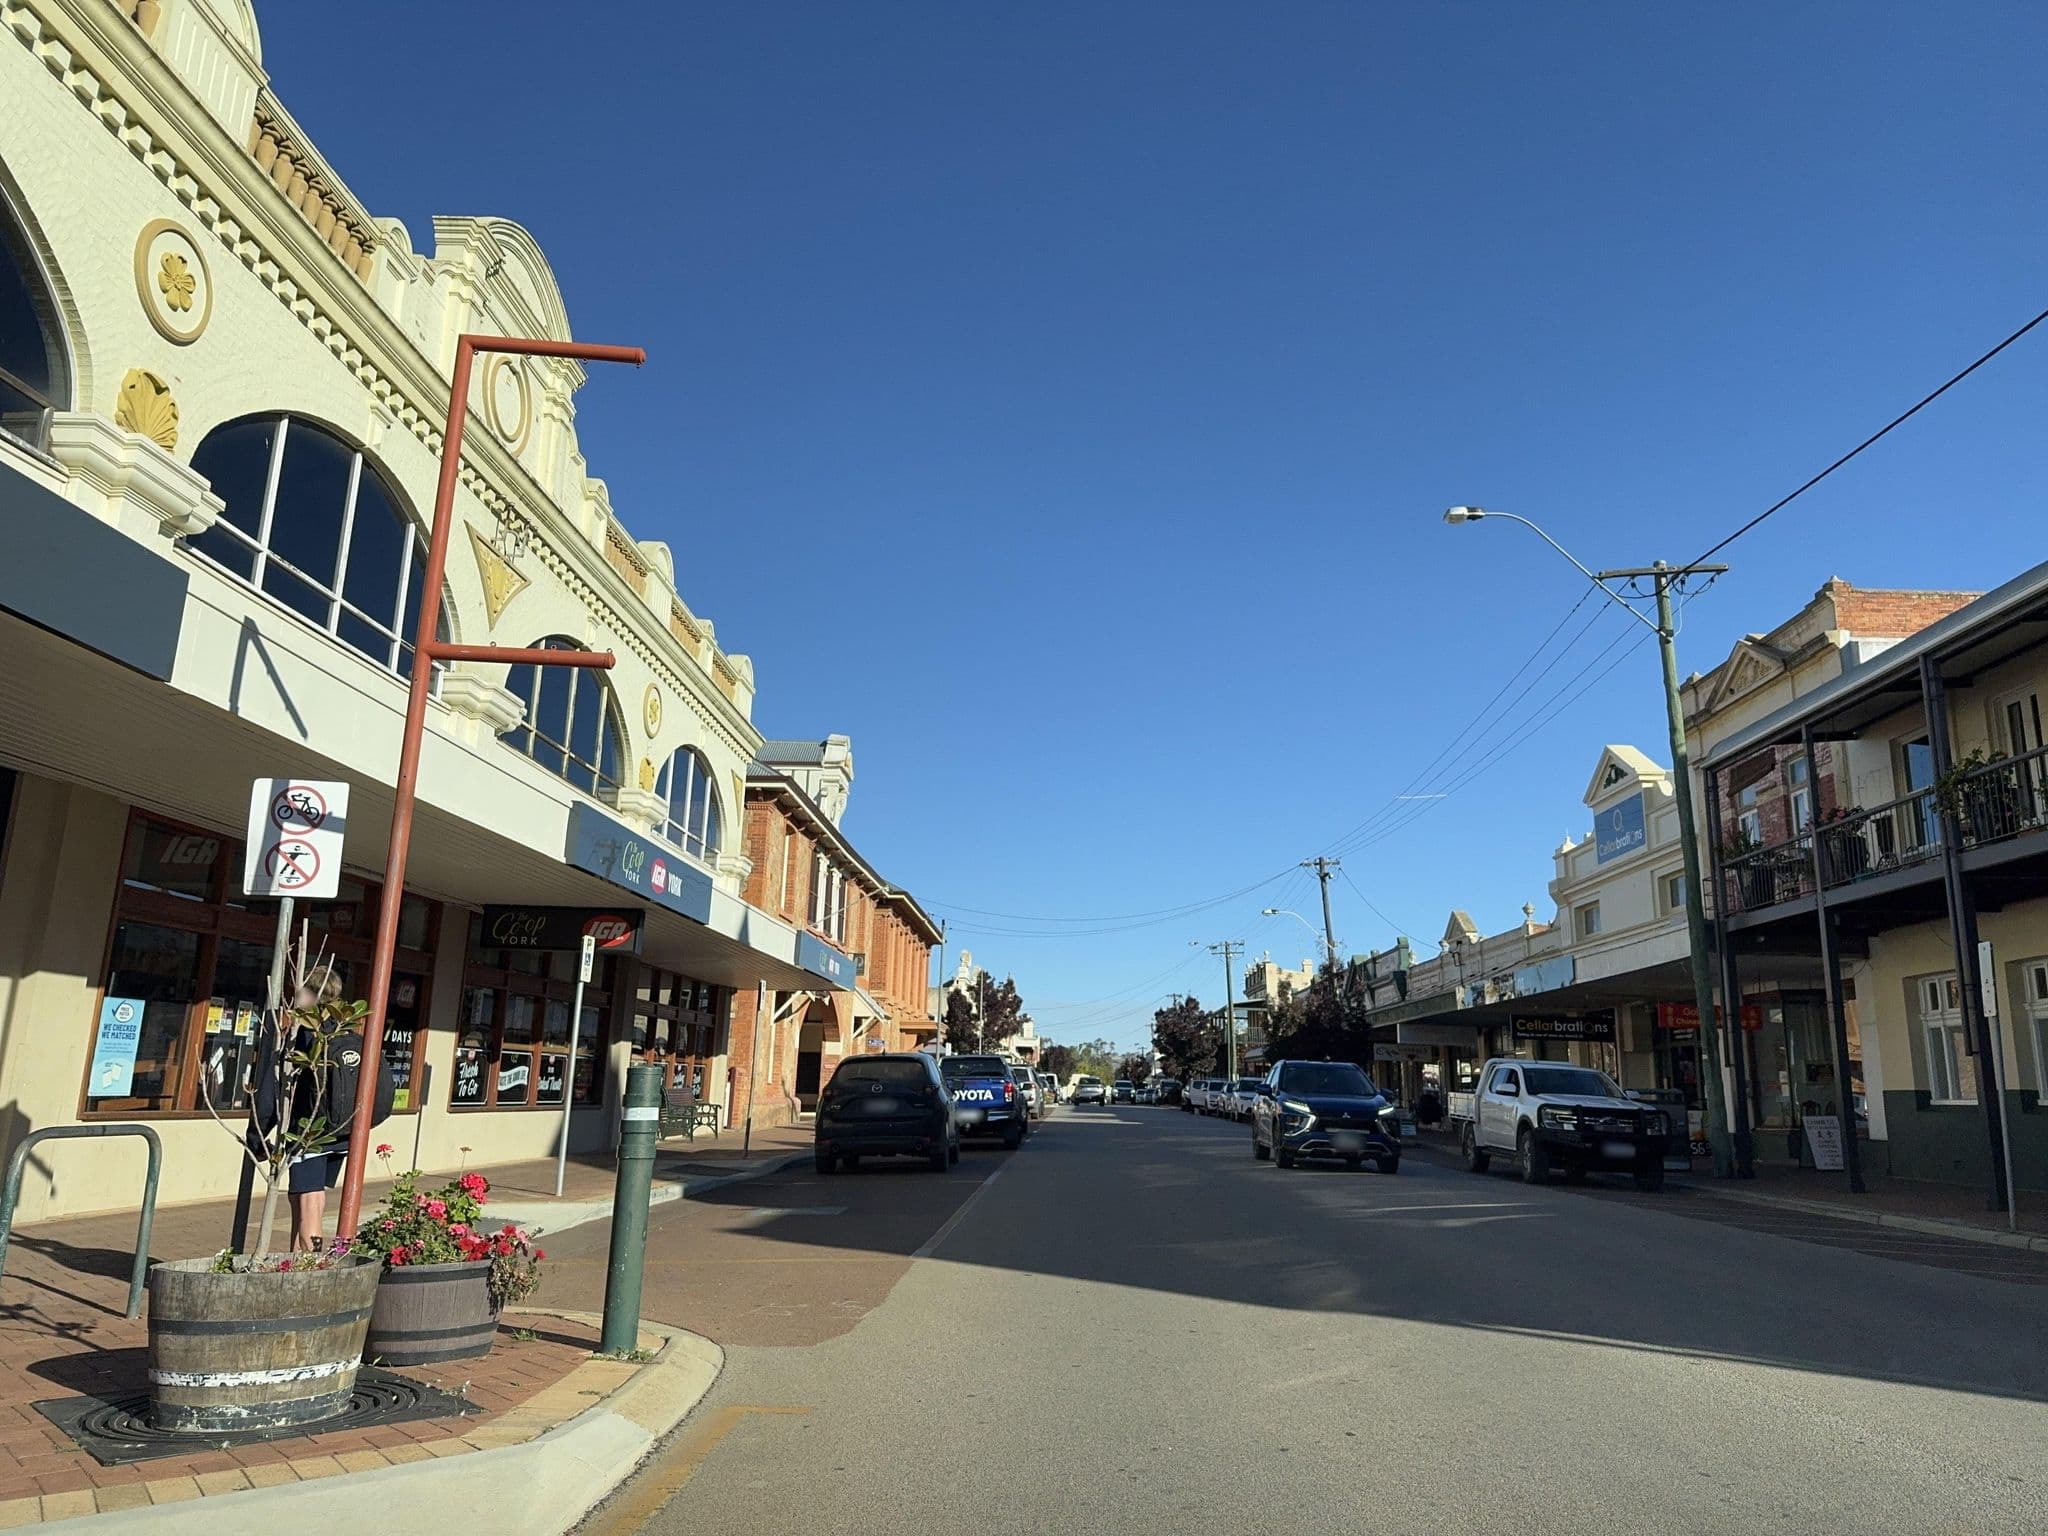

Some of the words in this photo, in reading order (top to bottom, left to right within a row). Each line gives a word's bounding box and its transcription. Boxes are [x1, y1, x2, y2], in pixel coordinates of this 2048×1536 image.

[160, 836, 219, 864] IGA
[625, 871, 640, 885] YORK
[651, 863, 667, 889] IGA
[667, 871, 683, 898] YORK
[588, 921, 628, 940] IGA
[500, 936, 538, 945] YORK
[103, 1023, 111, 1031] WE
[112, 1024, 137, 1033] CHECKED
[383, 1019, 395, 1042] 7
[391, 1029, 412, 1044] DAYS
[1516, 1019, 1609, 1034] Cellarbrations
[101, 1031, 110, 1039] WE
[110, 1032, 136, 1041] MATCHED
[459, 1060, 479, 1080] Fresh
[458, 1080, 468, 1097] To
[467, 1079, 479, 1096] Go
[952, 1089, 994, 1102] OYOTA
